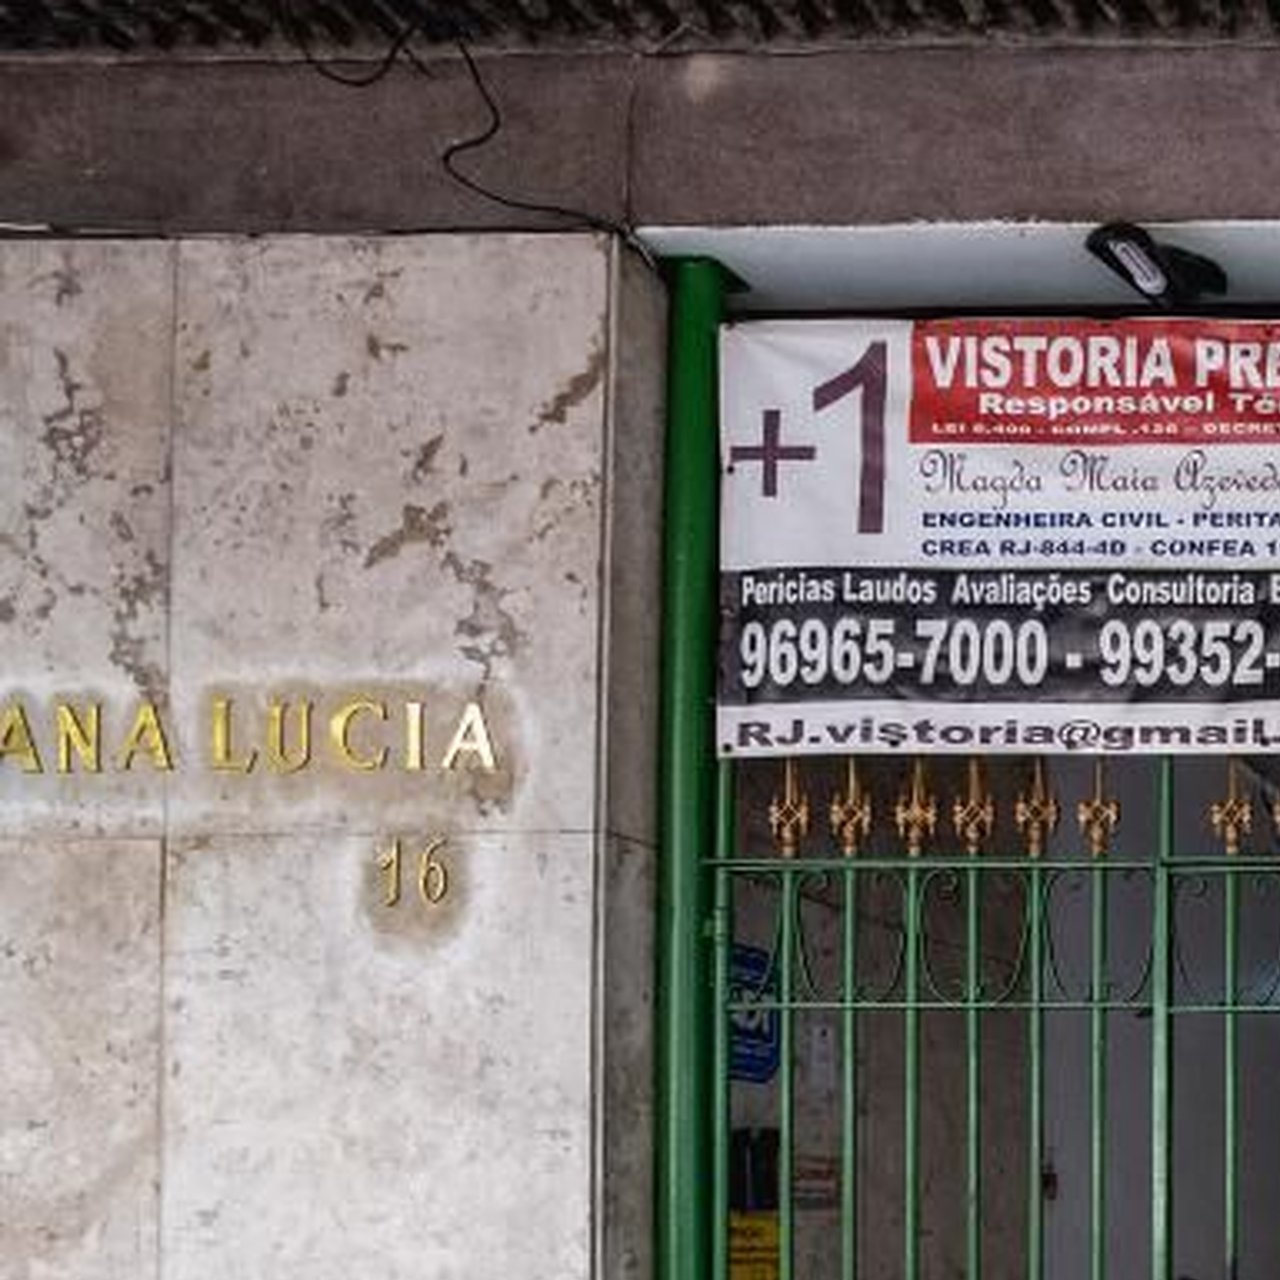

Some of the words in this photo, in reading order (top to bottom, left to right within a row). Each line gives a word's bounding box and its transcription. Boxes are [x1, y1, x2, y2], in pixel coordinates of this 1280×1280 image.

[926, 336, 1177, 390] VISTORIA
[979, 392, 1215, 419] Responsável
[920, 450, 1041, 509] Magda
[1060, 450, 1159, 492] Maia
[922, 511, 1094, 528] ENGENHEIRA
[1101, 511, 1169, 528] CIVIL
[922, 539, 991, 556] CREA
[1150, 539, 1255, 557] CONFEA
[843, 572, 939, 603] Laudos
[952, 573, 1092, 611] Avaliações
[1107, 573, 1256, 604] Consultoria
[740, 618, 1048, 687] 96965-7000
[376, 836, 448, 907] 16
